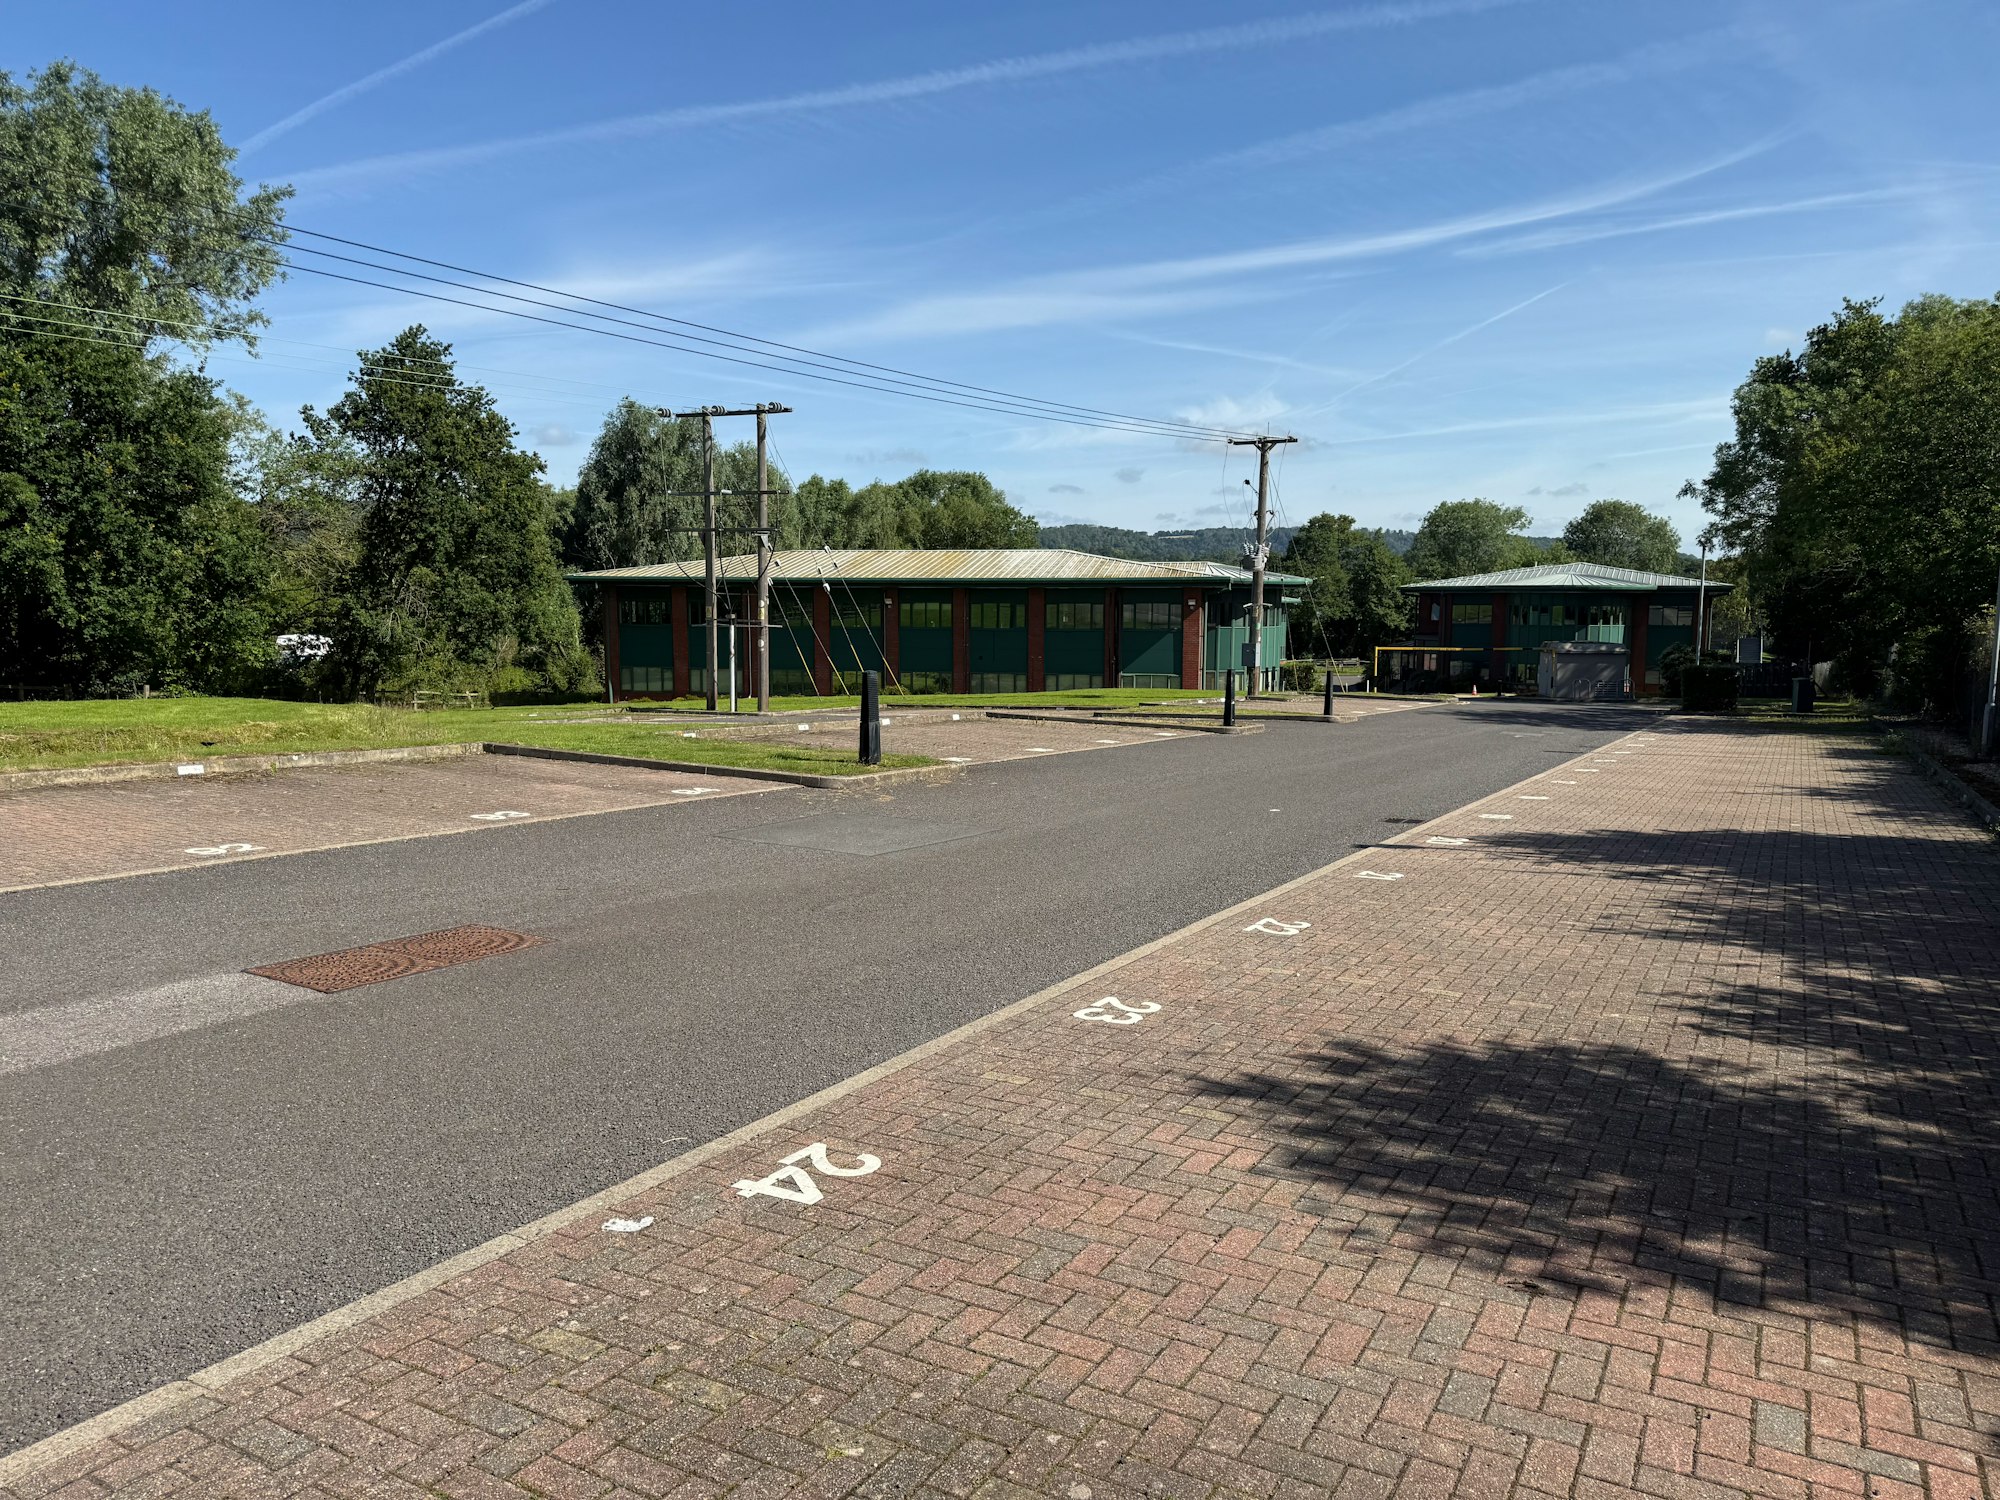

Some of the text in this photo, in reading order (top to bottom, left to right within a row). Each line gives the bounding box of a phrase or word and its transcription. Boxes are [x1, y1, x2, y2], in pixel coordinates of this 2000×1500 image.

[184, 843, 267, 855] 92
[1242, 917, 1312, 936] 22
[1072, 996, 1162, 1025] 23
[731, 1142, 882, 1205] 24
